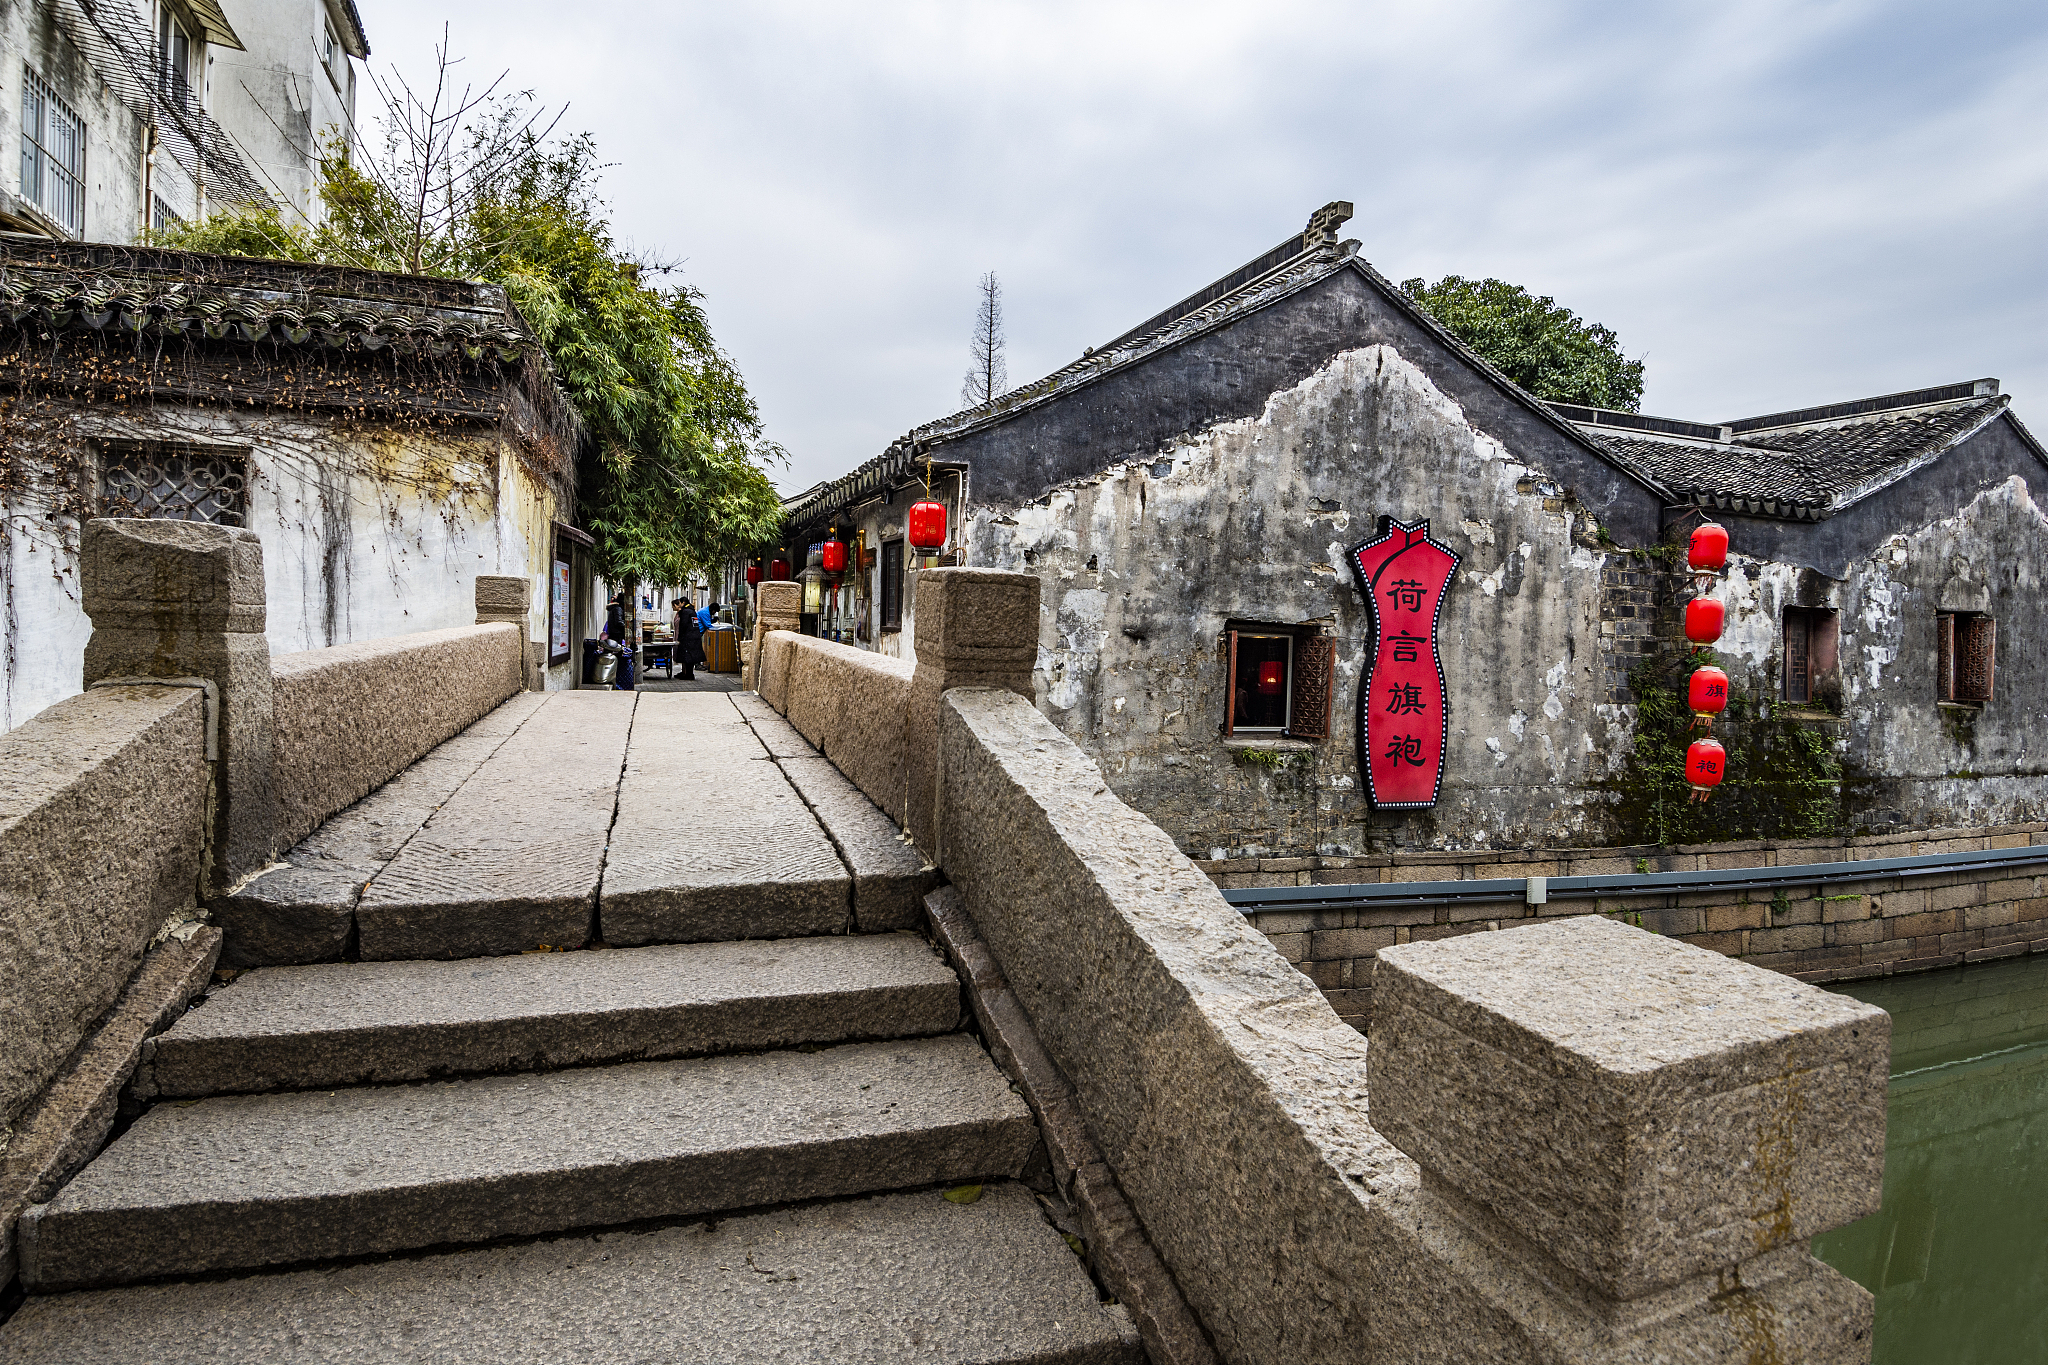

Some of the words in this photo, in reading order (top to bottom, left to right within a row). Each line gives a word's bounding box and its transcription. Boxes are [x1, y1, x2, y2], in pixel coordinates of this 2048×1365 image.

[1385, 579, 1428, 768] 荷言旗袍
[1705, 684, 1725, 698] 旗
[1696, 760, 1718, 774] 袍
